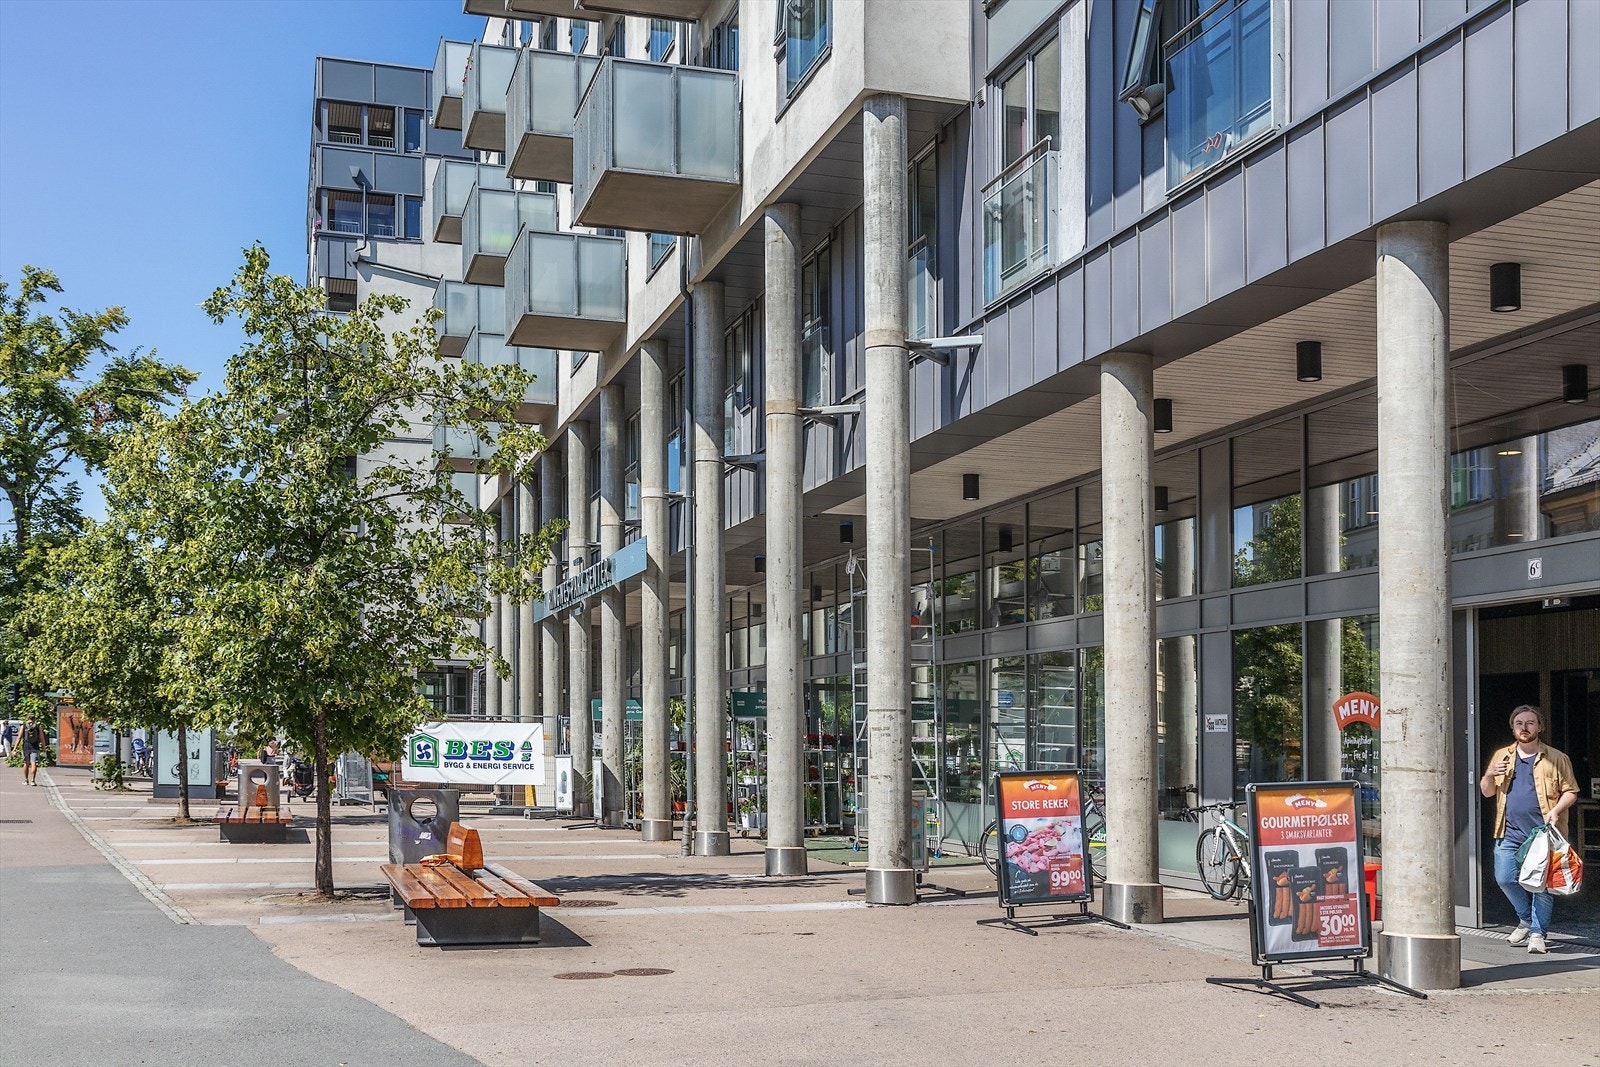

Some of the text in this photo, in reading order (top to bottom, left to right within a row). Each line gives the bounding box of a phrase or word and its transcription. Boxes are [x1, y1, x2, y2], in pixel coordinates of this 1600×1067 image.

[1338, 698, 1380, 720] MENY
[444, 739, 515, 761] BES
[444, 761, 464, 769] BYGG
[502, 762, 535, 770] SERVICE
[1011, 798, 1069, 811] STORE REKER
[1294, 800, 1315, 808] MENY
[1261, 813, 1350, 829] GOURMETPØLSER
[1280, 828, 1333, 839] 3 SMAKSVARIANTER
